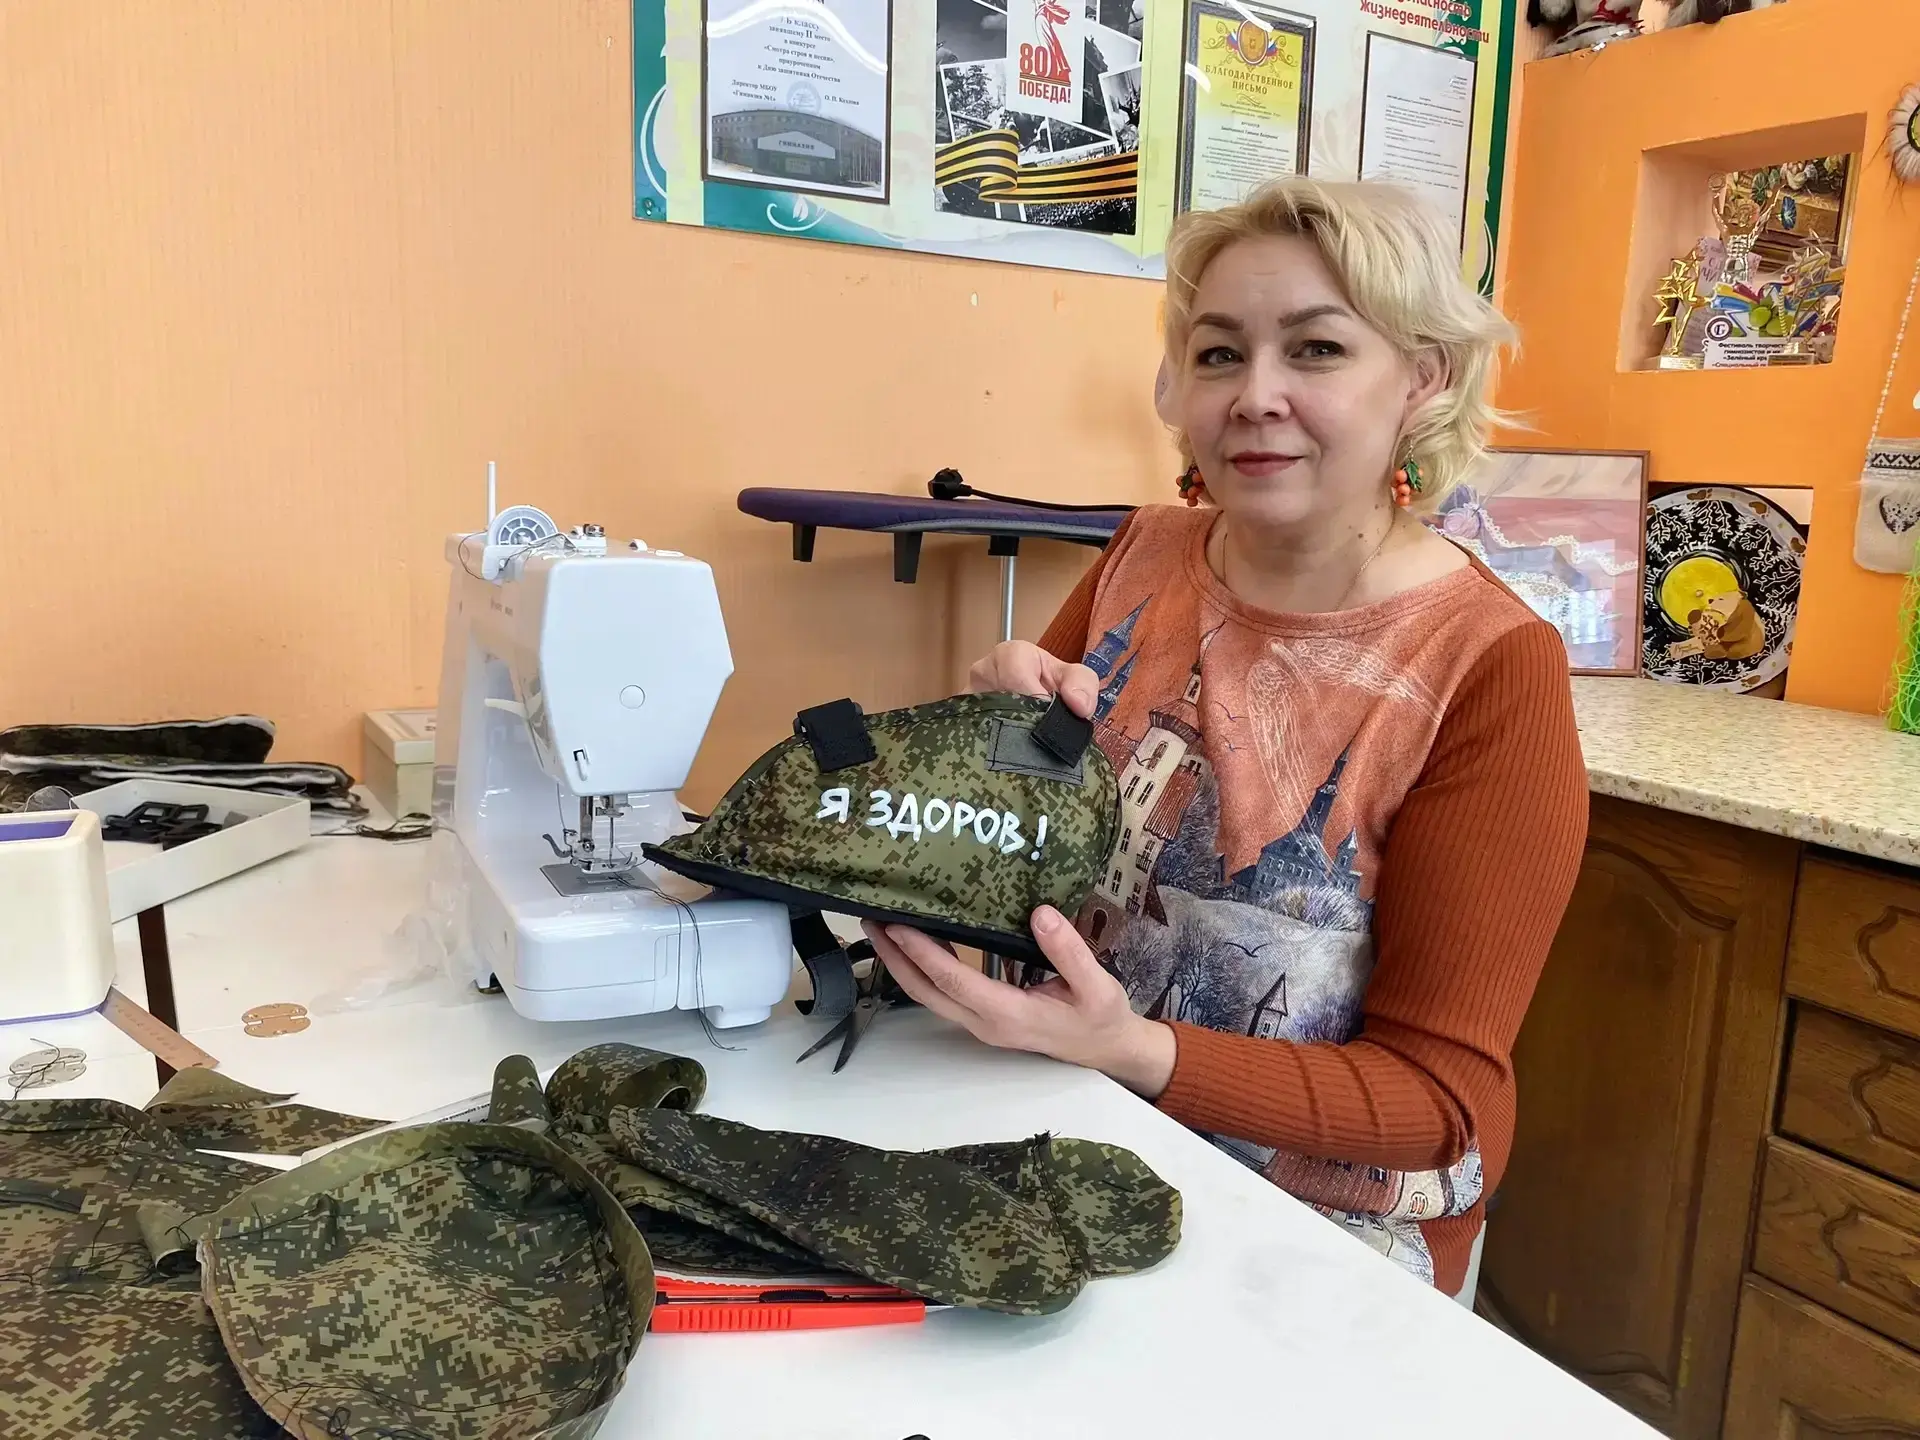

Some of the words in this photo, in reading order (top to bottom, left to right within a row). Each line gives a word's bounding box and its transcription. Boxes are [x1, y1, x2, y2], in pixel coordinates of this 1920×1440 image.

[1360, 1, 1490, 43] жизнедеятельности
[769, 25, 804, 38] занявшему
[806, 29, 813, 38] II
[814, 33, 831, 42] место
[789, 40, 816, 49] конкурсе
[1019, 43, 1051, 77] 80
[763, 64, 777, 72] Дню
[811, 72, 841, 83] Отечества
[1205, 65, 1294, 89] БЛАГОДАРСТВЕННОЕ
[732, 79, 759, 90] Директор
[760, 83, 777, 91] МБОУ
[1019, 79, 1071, 104] ПОБЕДА!
[1232, 80, 1268, 95] ПИСЬМО
[816, 787, 850, 824] Я
